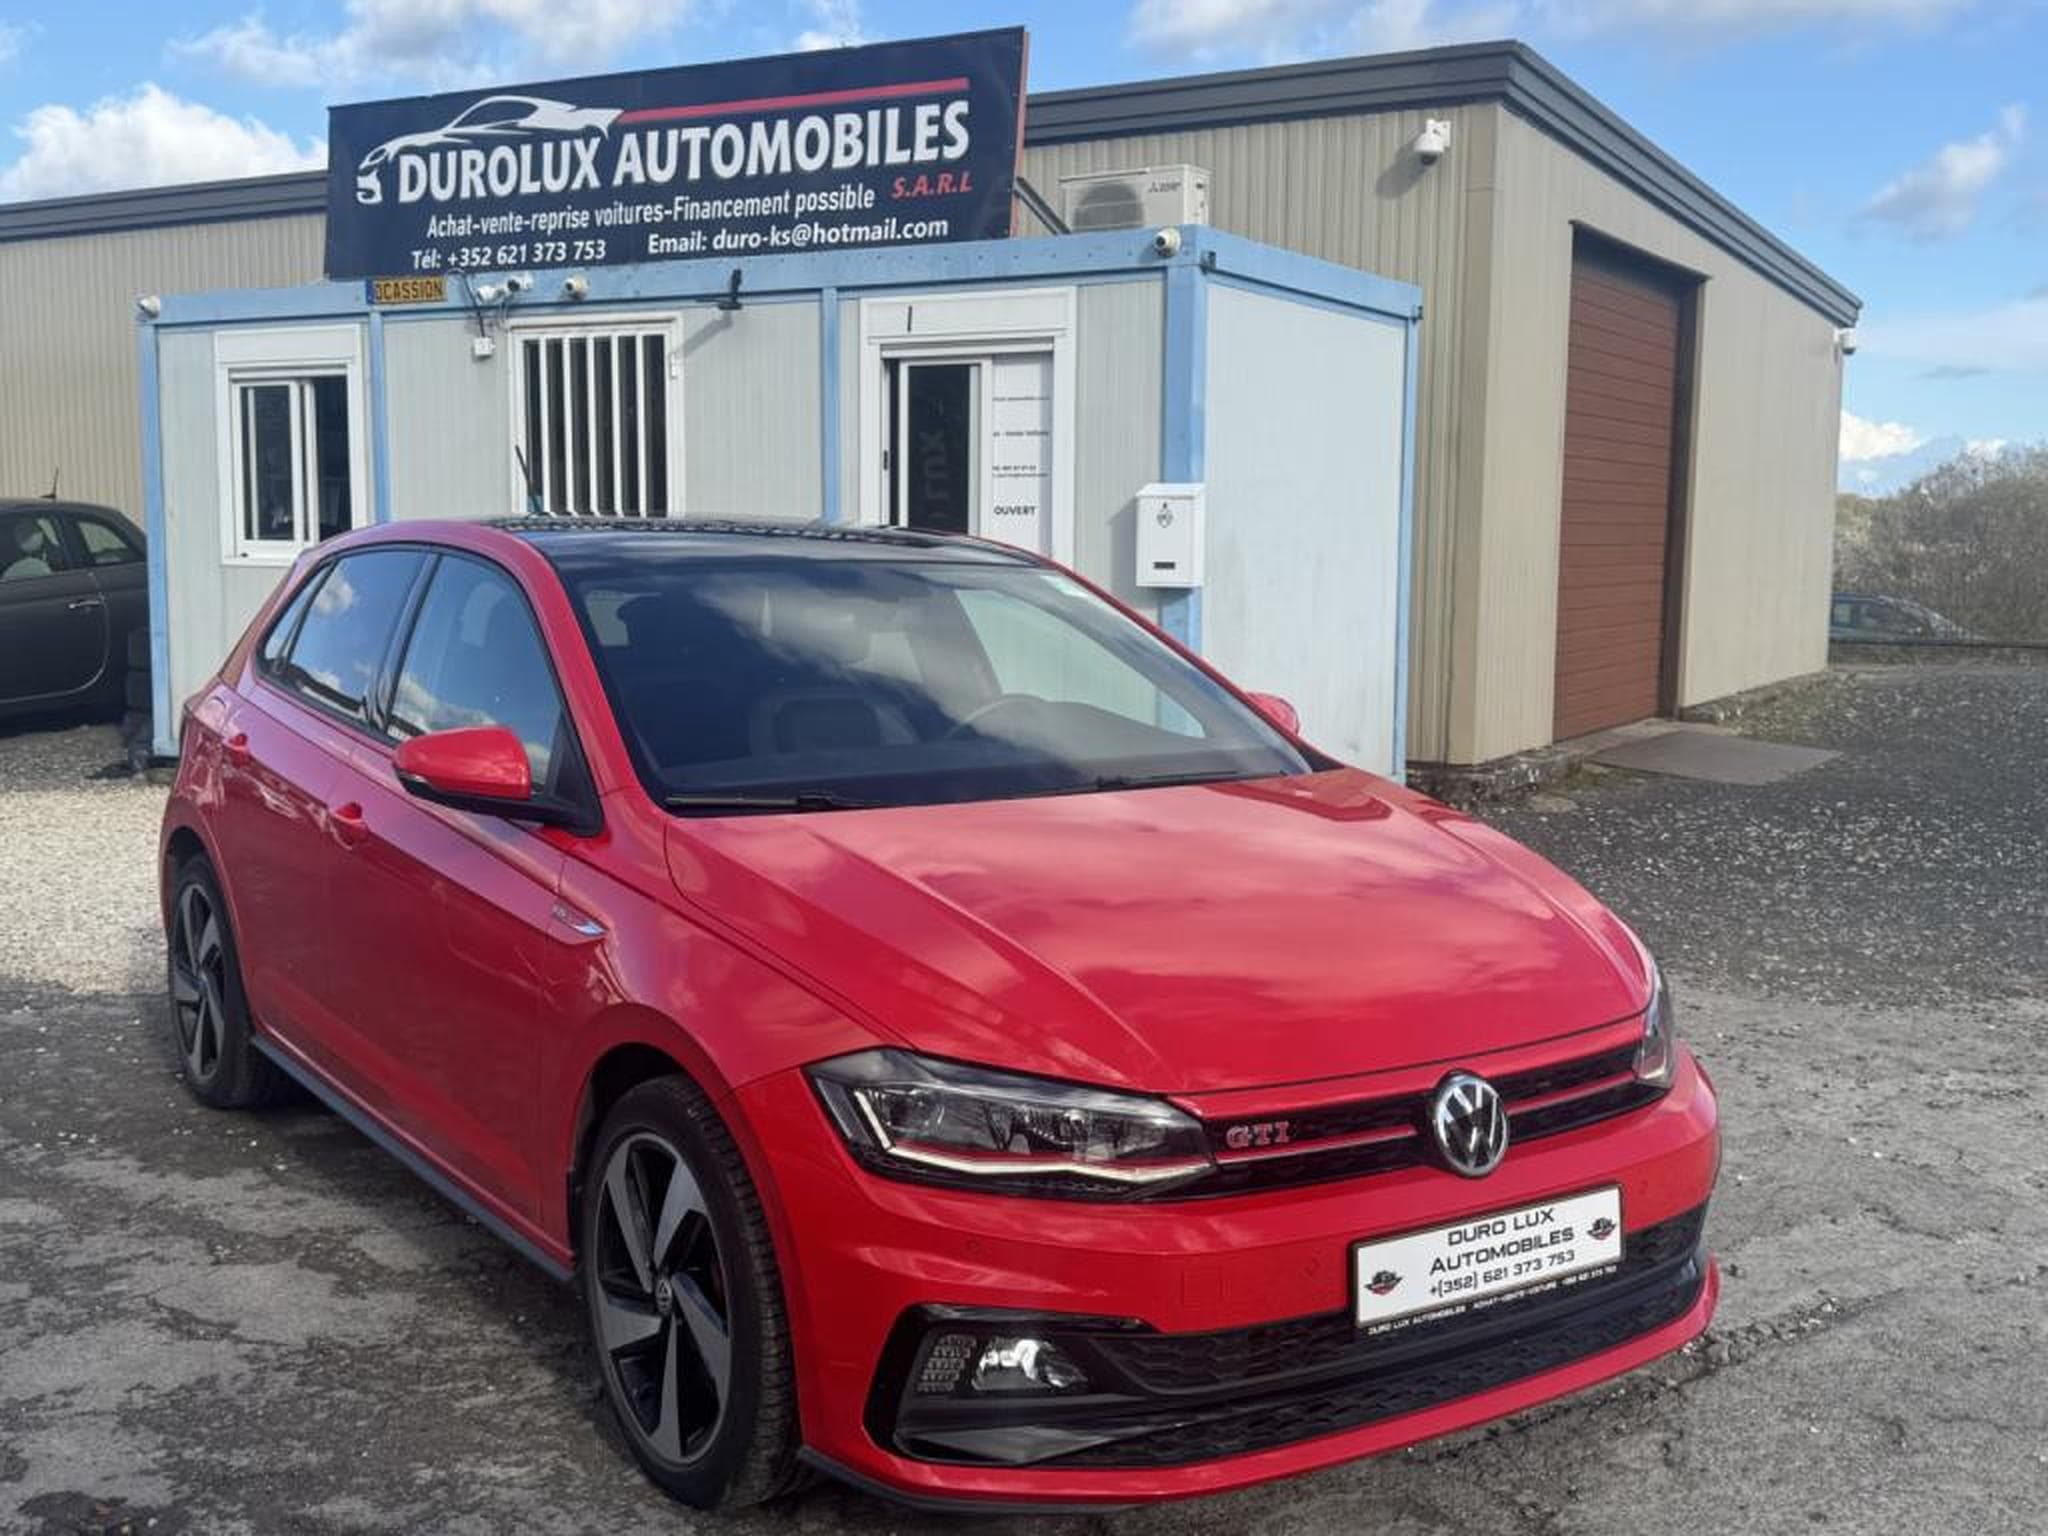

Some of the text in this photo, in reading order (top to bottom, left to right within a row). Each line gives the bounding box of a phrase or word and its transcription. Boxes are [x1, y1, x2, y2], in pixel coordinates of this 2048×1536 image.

[399, 101, 970, 202] DUROLUX AUTOMOBILES
[891, 171, 972, 199] S.A.R.L
[427, 183, 875, 238] Achat-vente-reprise voitures-Financement possible
[648, 218, 949, 254] Email: duro-ks@hotmail.com
[411, 240, 606, 269] Tél: +352 621 373 753
[993, 505, 1037, 516] OUVERT
[1226, 1121, 1290, 1148] GTI
[1448, 1208, 1555, 1246] DURO LUX
[1429, 1227, 1575, 1275] AUTOMOBILES
[1483, 1267, 1509, 1283] 621
[1513, 1259, 1543, 1276] 373
[1549, 1250, 1575, 1267] 753
